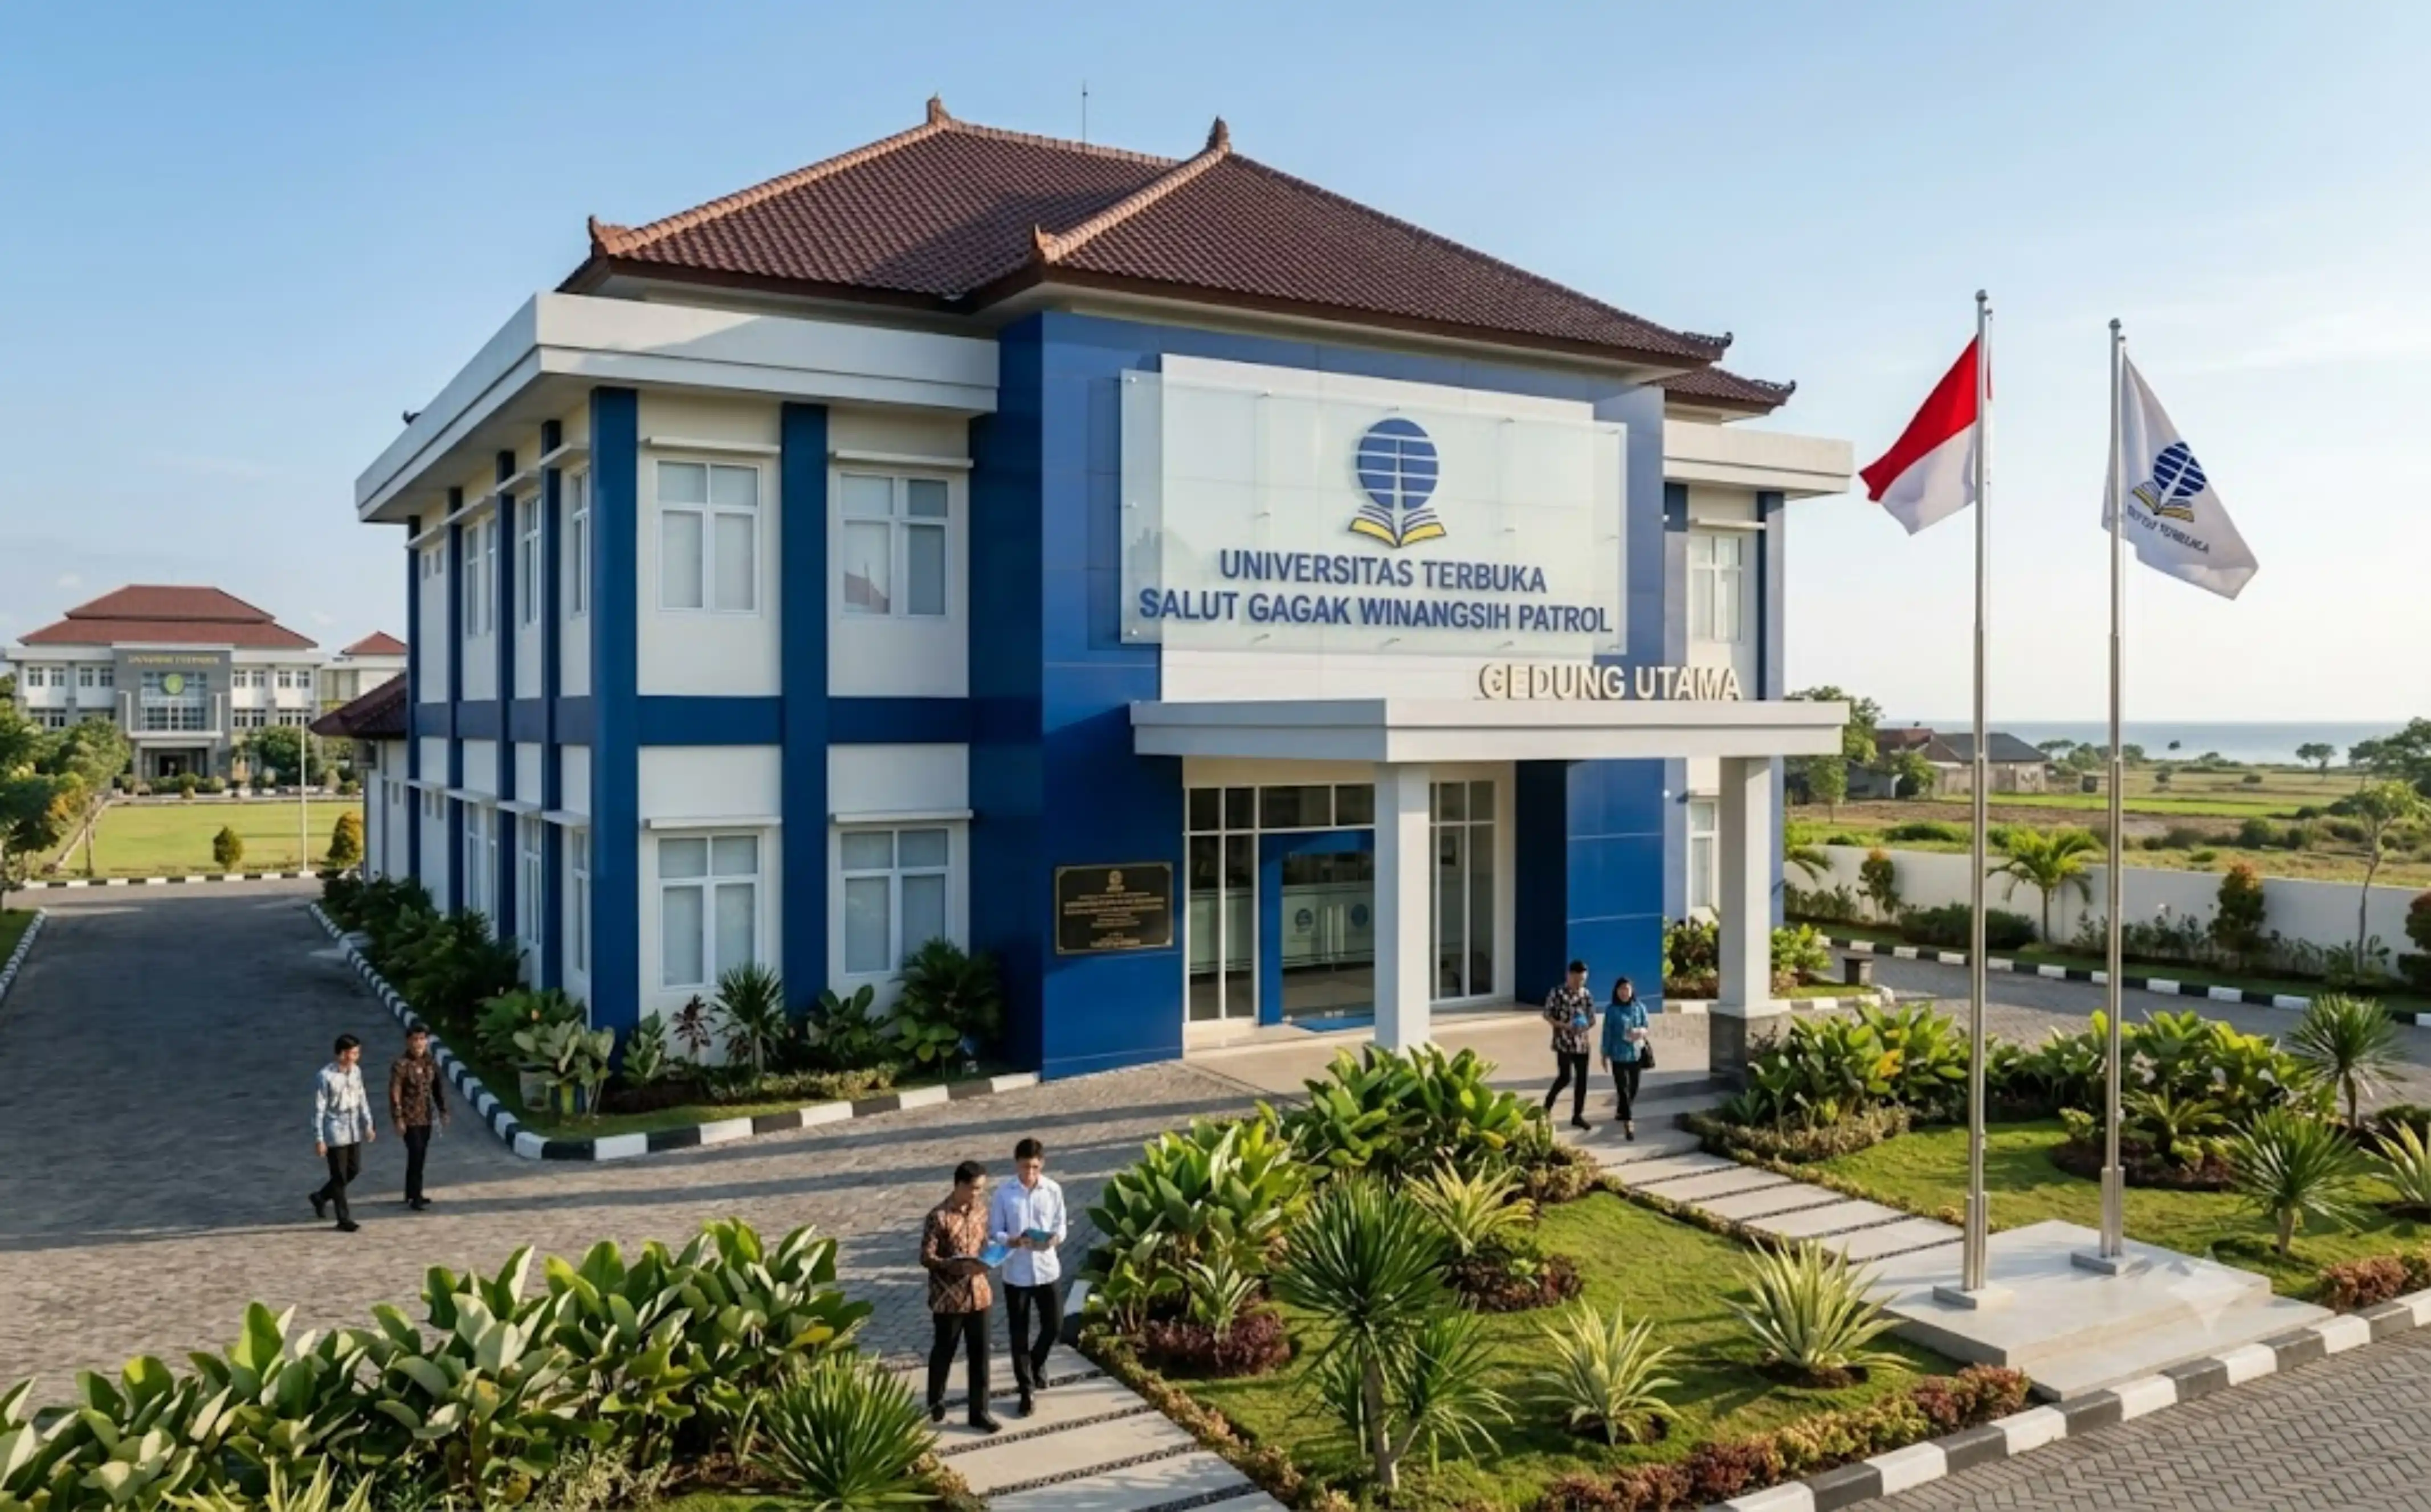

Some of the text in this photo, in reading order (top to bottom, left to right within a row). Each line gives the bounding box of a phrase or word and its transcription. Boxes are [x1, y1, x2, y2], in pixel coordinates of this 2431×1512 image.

[1219, 549, 1547, 593] UNIVERSITAS TERBUKA
[1139, 588, 1613, 632] SALUT GAGAK WINANGSIH PATROL
[1479, 664, 1744, 701] GEDUNG UTAMA
